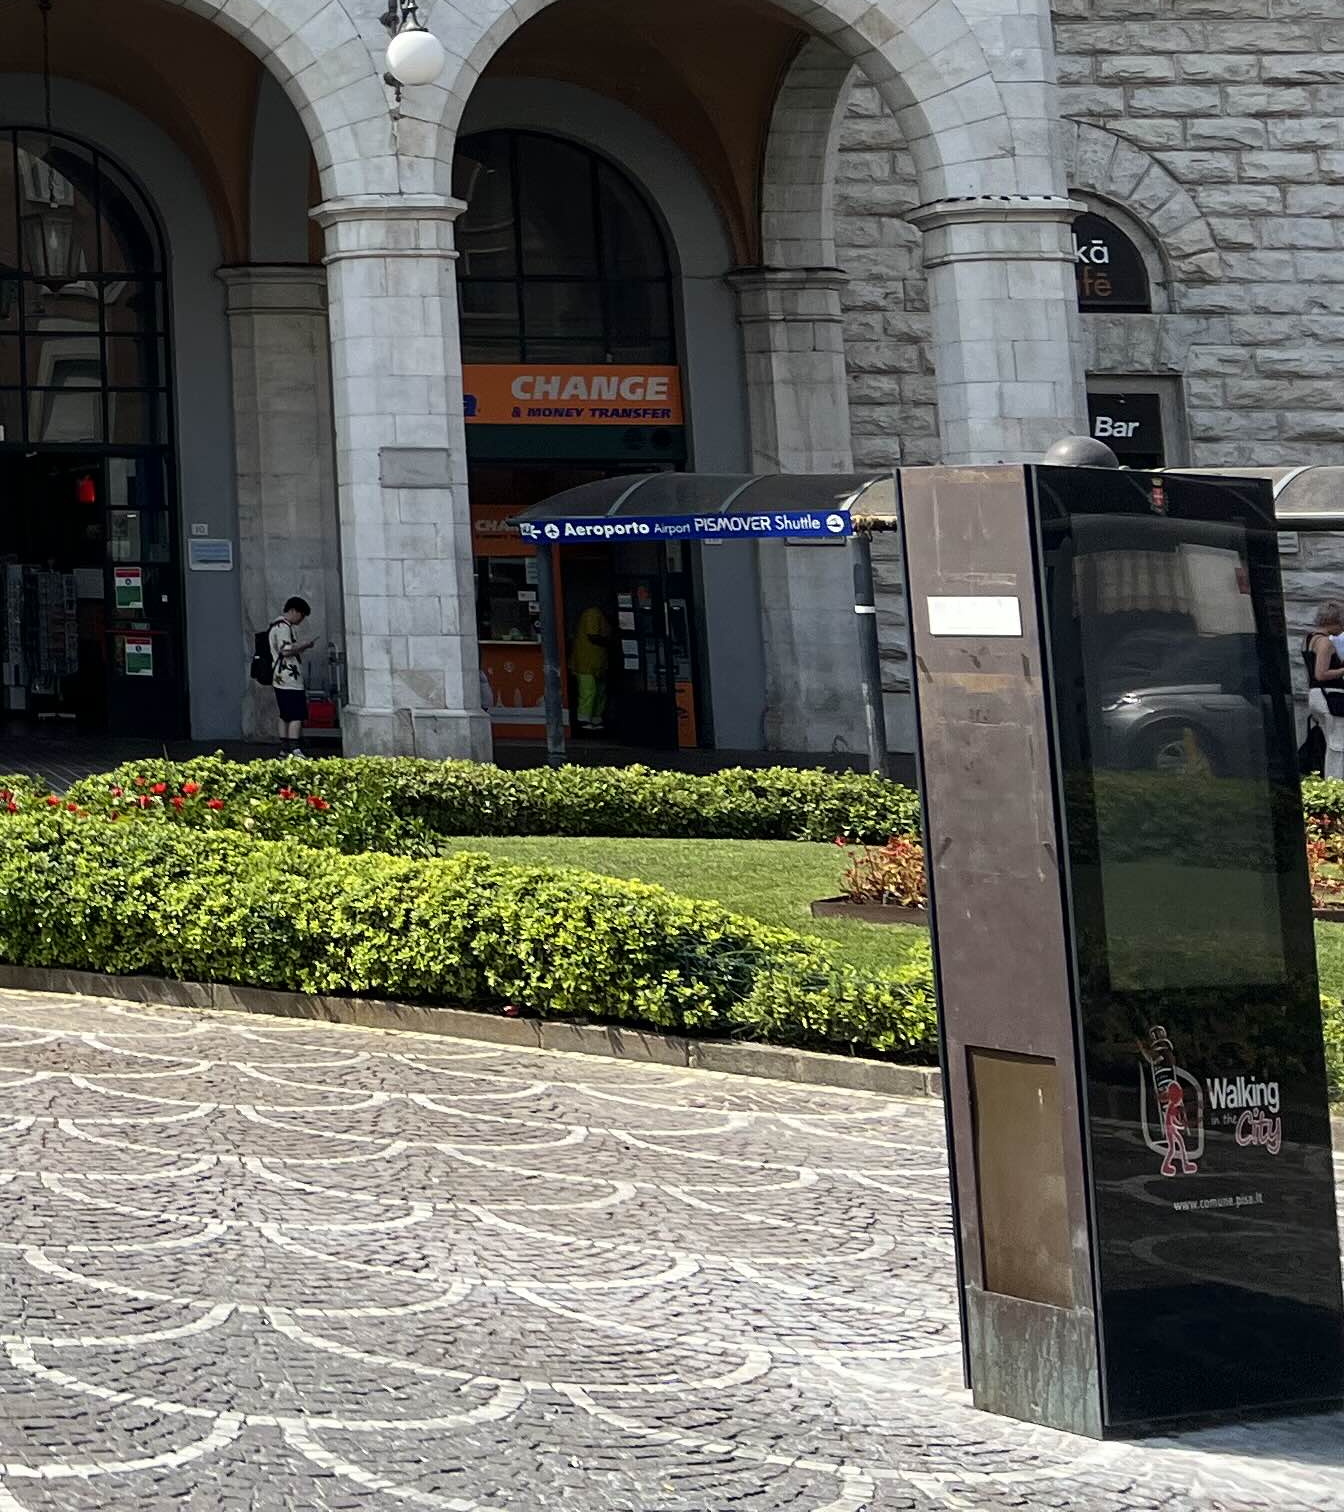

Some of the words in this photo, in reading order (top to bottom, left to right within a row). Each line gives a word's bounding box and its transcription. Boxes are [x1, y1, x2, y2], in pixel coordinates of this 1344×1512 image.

[512, 376, 669, 401] CHANGE
[527, 408, 584, 418] MONEY
[589, 408, 672, 419] TRANSFER
[1094, 416, 1139, 437] Bar
[565, 522, 650, 539] Aeroporto
[654, 523, 691, 535] Airport
[695, 516, 771, 532] PISMOVER
[775, 514, 821, 530] Shuttle
[1207, 1076, 1280, 1113] Walking
[1235, 1107, 1282, 1155] City
[1173, 1192, 1263, 1211] www.comune.pisa.it
